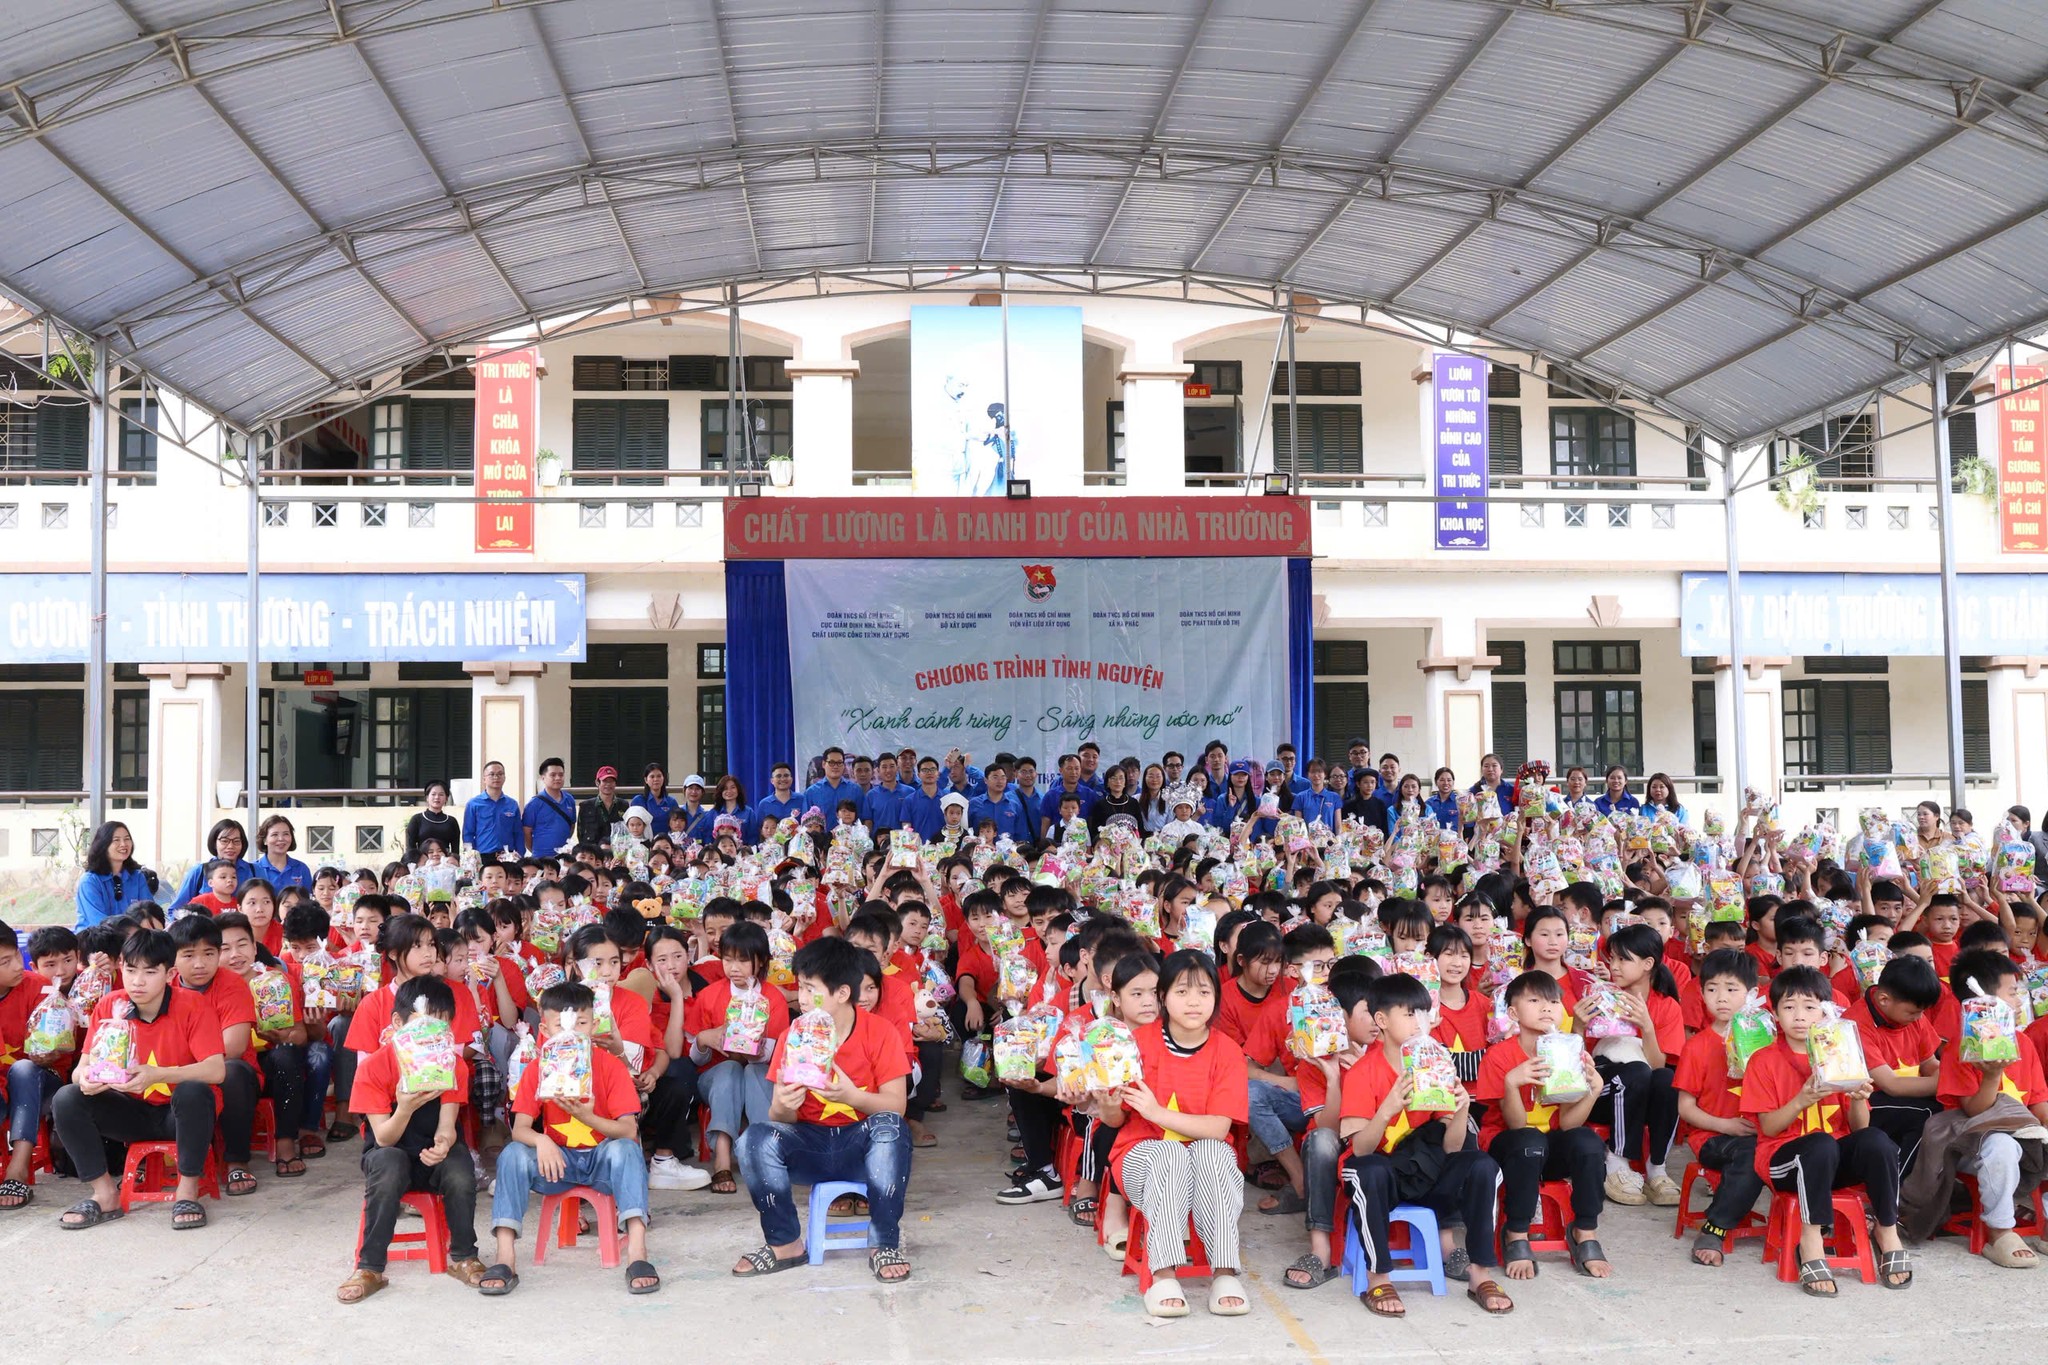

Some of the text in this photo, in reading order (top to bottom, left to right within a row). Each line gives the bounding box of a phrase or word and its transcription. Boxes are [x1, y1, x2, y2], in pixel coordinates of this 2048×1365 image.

[482, 361, 530, 378] TRI THỨC
[1448, 365, 1472, 381] LUÔN
[2001, 378, 2020, 391] HC
[499, 386, 512, 404] LÀ
[1467, 386, 1480, 402] TỚI
[2004, 397, 2040, 412] VÀ LÀM
[492, 410, 519, 429] CHÌA
[2010, 419, 2035, 432] THEO
[490, 437, 520, 455] KHÓA
[1464, 431, 1481, 445] CAO
[2013, 436, 2034, 453] TẤM
[1452, 449, 1470, 467] CỦA
[2007, 459, 2040, 473] GƯƠNG
[483, 459, 527, 480] MỞ CỬA
[1442, 472, 1481, 488] TRI THỨC
[2003, 479, 2045, 496] ĐẠO ĐỨC
[2010, 498, 2041, 515] HỒ CHÍ
[496, 516, 513, 531] LAI
[744, 500, 1293, 548] CHẤT LƯỢNG LÀ DANH DỰ CỦA NHÀ TRƯỜNG
[1440, 517, 1484, 534] KHOA HỌC
[2012, 522, 2039, 535] MINH
[143, 592, 208, 647] TÌNH
[364, 592, 456, 648] TRÁCH
[464, 591, 556, 653] NHIỆM
[914, 654, 1164, 691] CHƯƠNG TRÌNH TÌNH NGUYỆN
[915, 706, 963, 730] cánh
[966, 712, 1012, 741] rừng
[1036, 706, 1096, 740] Sáng
[1103, 706, 1161, 740] những
[1166, 706, 1200, 729] ước
